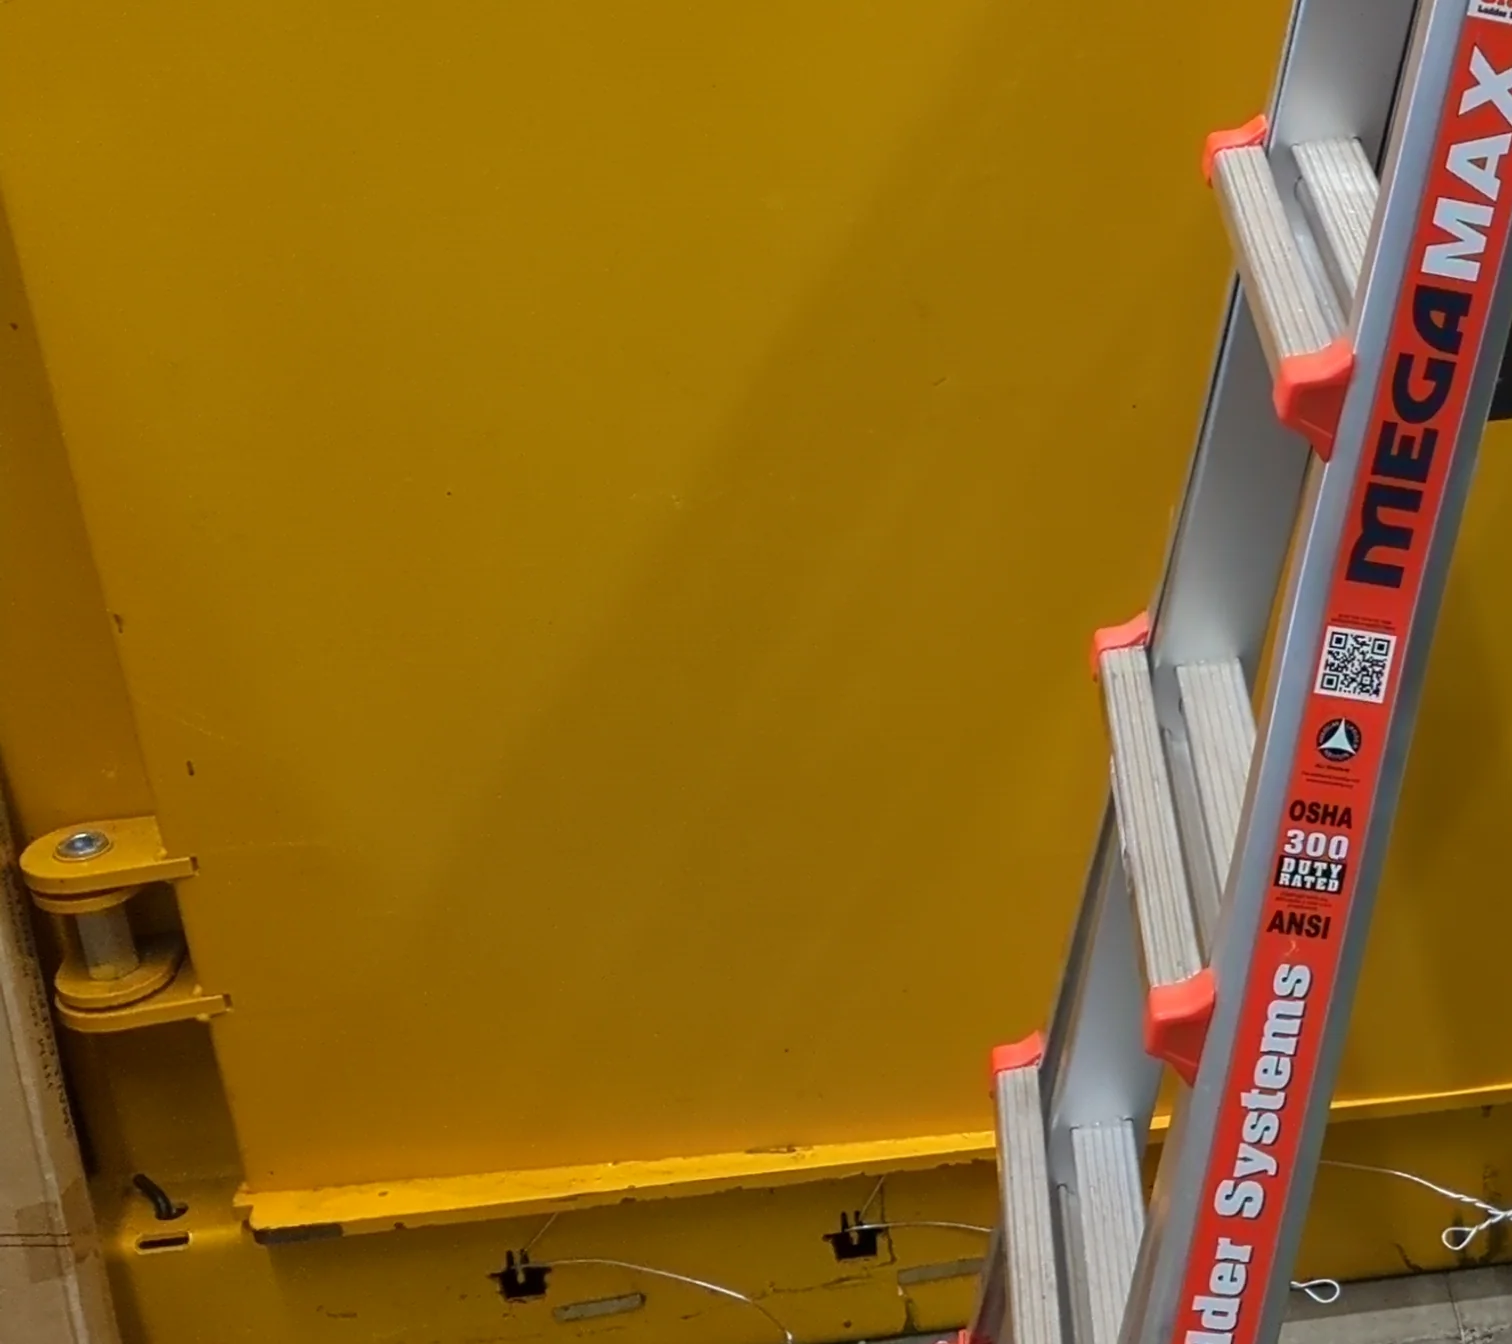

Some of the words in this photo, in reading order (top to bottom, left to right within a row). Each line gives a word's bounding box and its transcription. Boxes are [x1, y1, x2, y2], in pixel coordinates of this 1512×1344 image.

[1477, 4, 1508, 19] Ladder
[1288, 799, 1353, 830] OSHA
[1283, 829, 1349, 860] 300
[1278, 873, 1340, 893] RATED
[1282, 857, 1344, 880] DUTY
[1266, 910, 1331, 940] ANSI
[1213, 962, 1312, 1220] Systems
